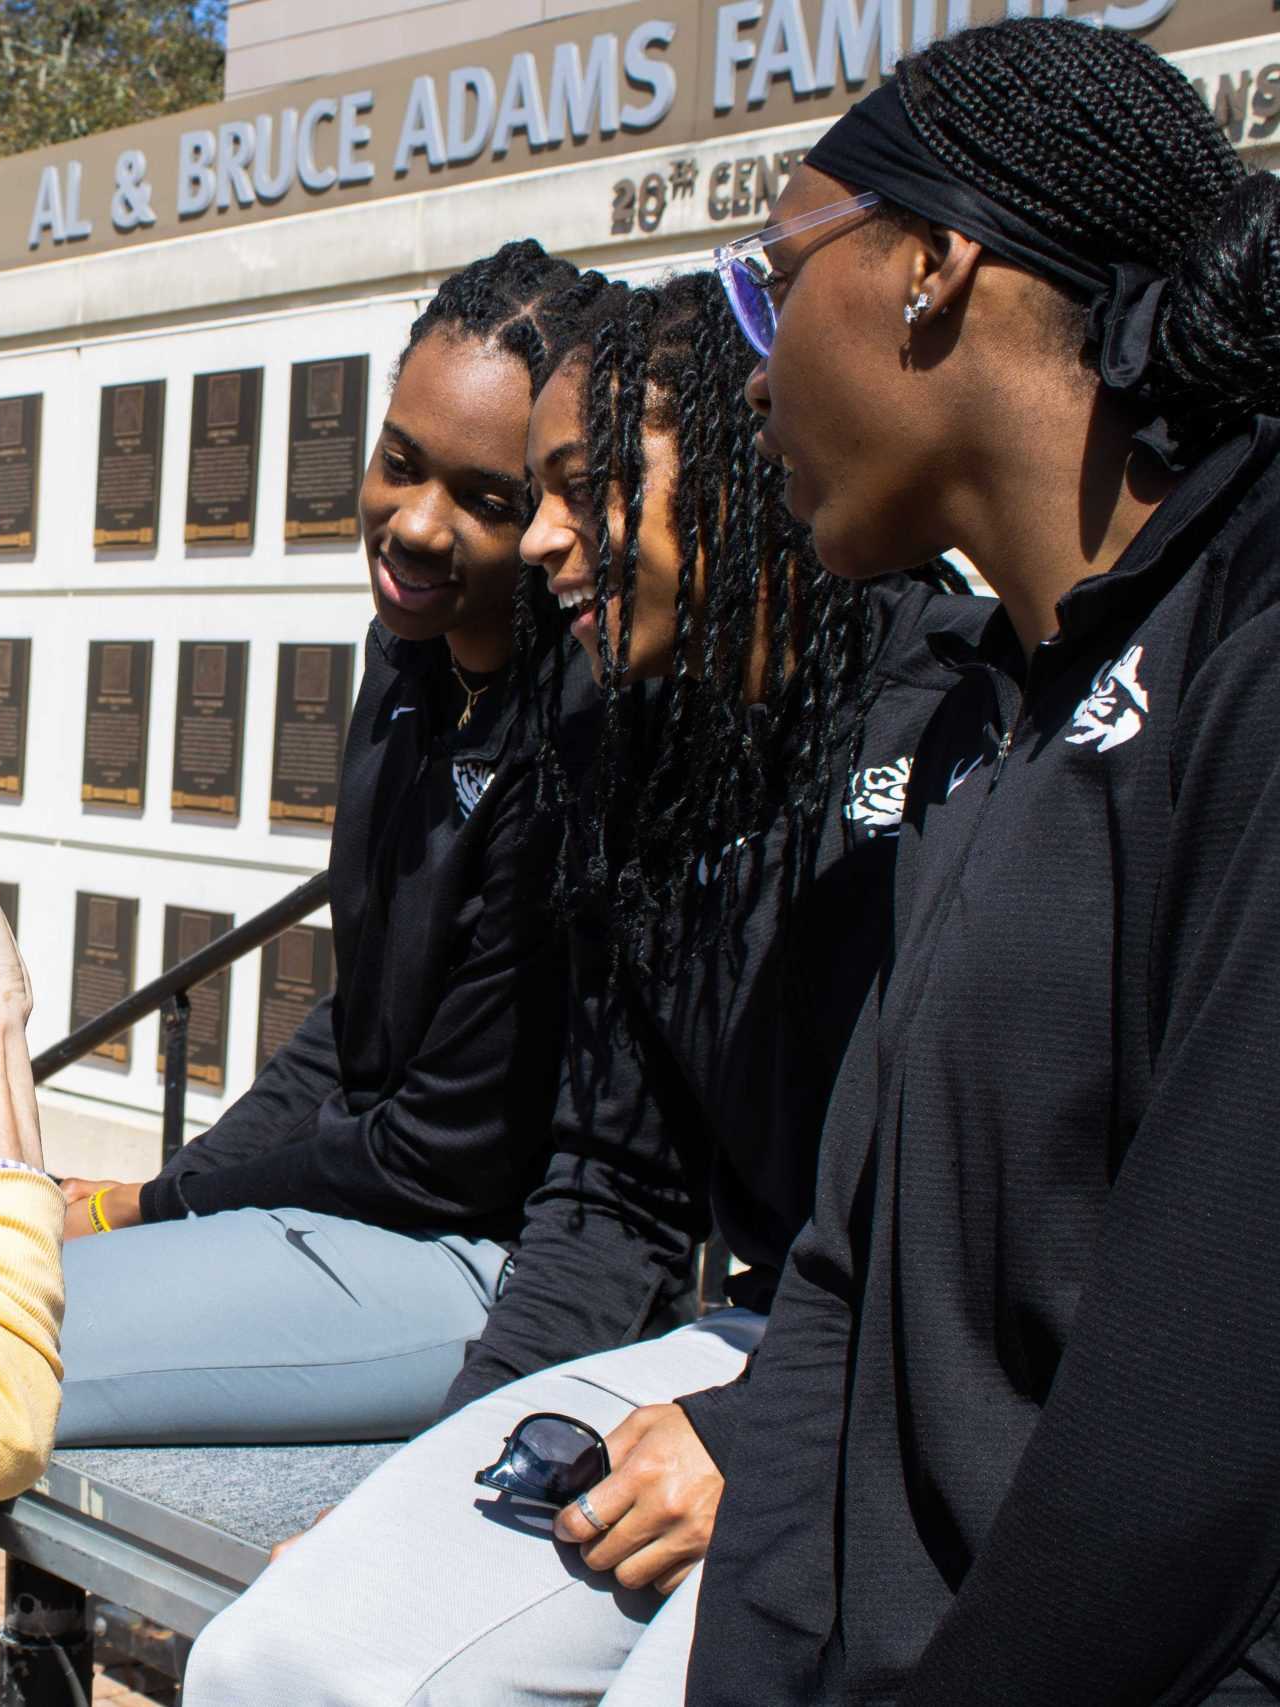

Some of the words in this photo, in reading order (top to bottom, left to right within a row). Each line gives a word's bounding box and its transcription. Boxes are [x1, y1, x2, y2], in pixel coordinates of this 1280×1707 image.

[29, 159, 93, 246] AL
[111, 149, 156, 229] &
[177, 91, 374, 217] BRUCE
[393, 20, 676, 172] ADAMS
